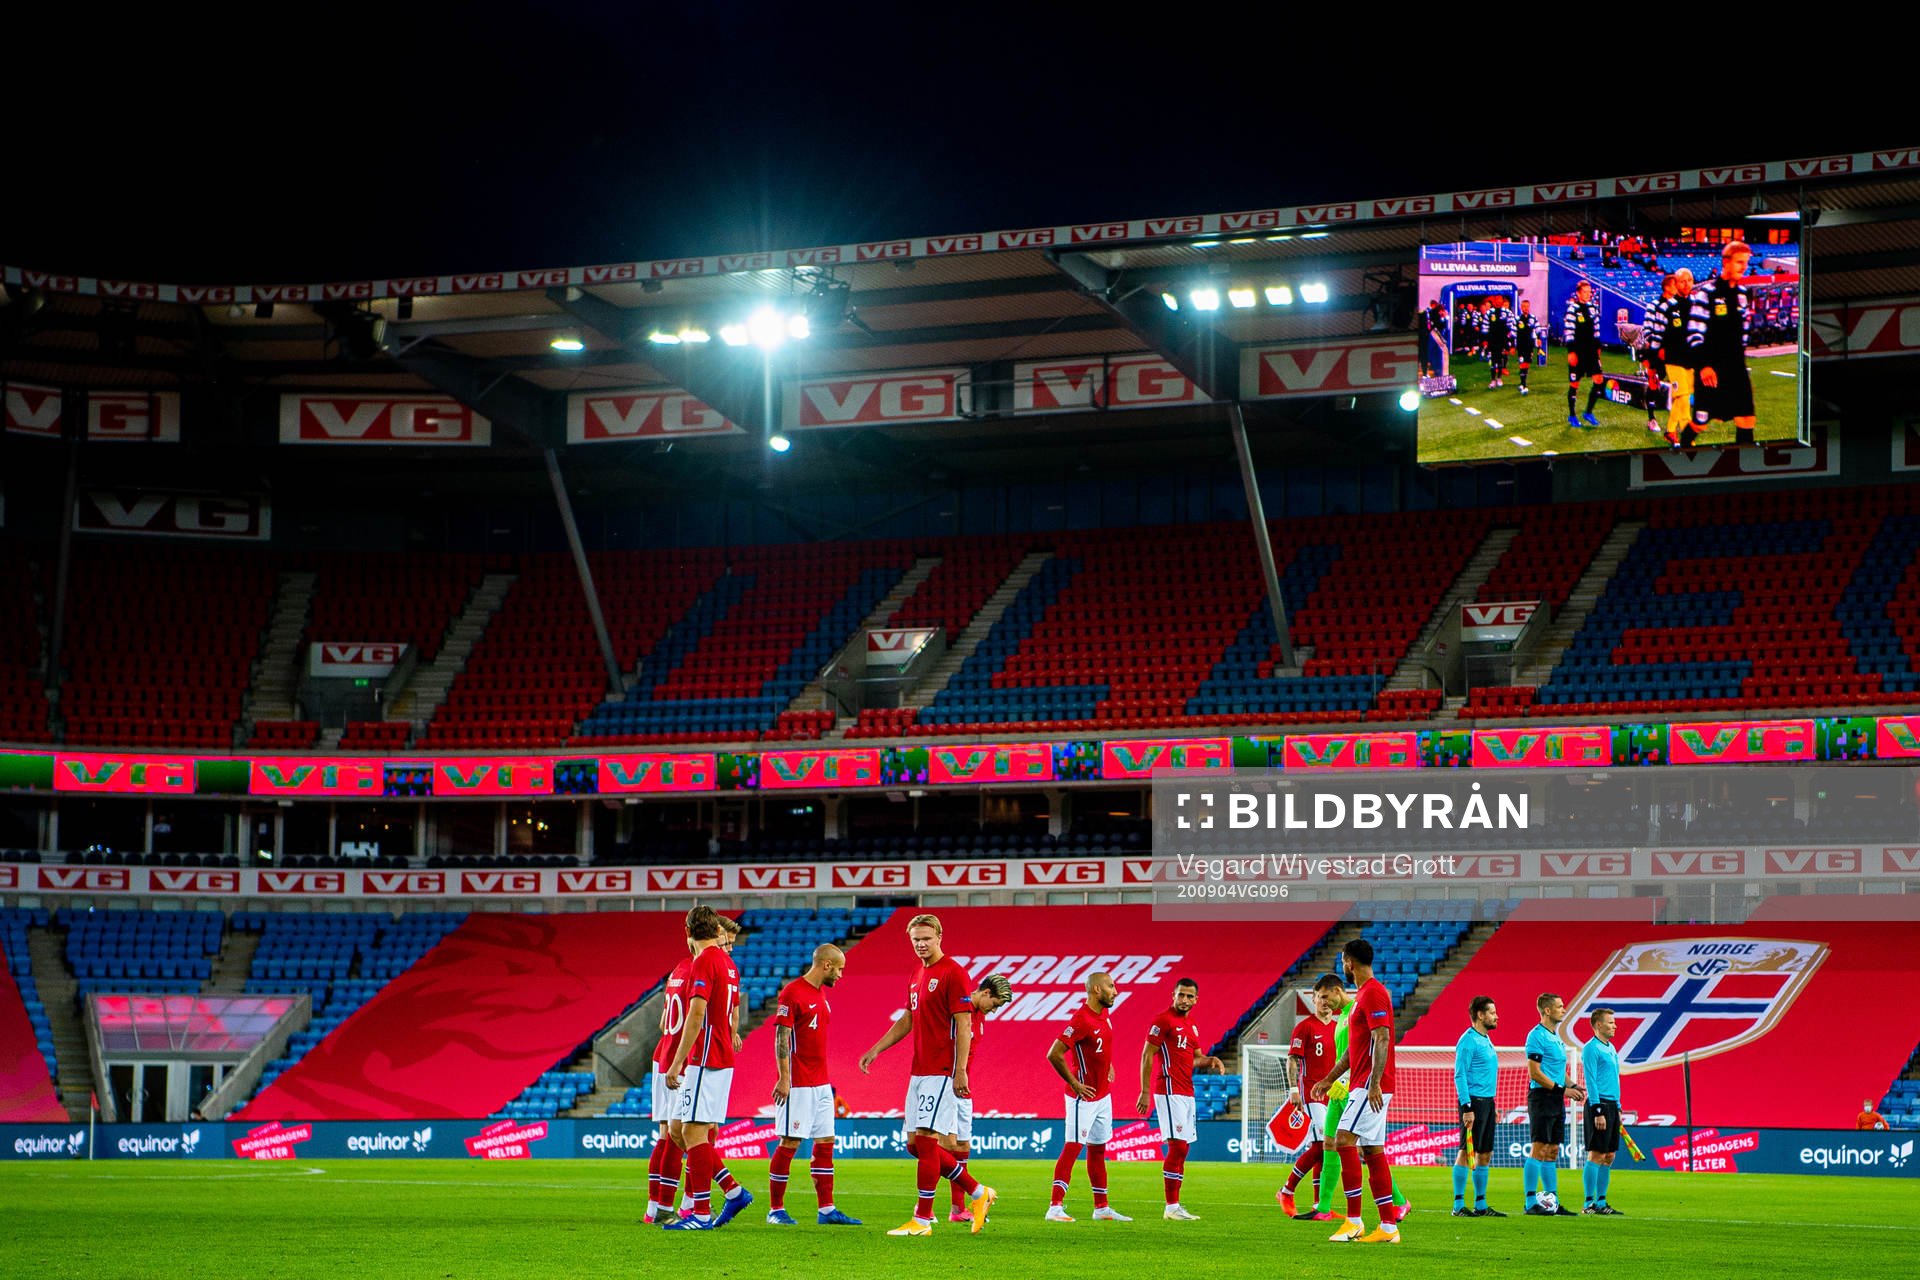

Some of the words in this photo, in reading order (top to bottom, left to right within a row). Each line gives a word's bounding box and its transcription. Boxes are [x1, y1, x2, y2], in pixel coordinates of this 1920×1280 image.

[26, 271, 75, 291] VG
[103, 281, 154, 299] VG
[180, 286, 233, 303] VG
[255, 286, 305, 302] VG
[325, 283, 372, 299] VG
[389, 278, 436, 295] VG
[453, 273, 501, 291] VG
[519, 269, 566, 288] VG
[586, 264, 633, 282] VG
[653, 260, 702, 277] VG
[788, 248, 838, 266] VG
[858, 241, 908, 260] VG
[930, 235, 980, 254] VG
[1001, 230, 1053, 248] VG
[1073, 223, 1126, 242] VG
[1146, 216, 1202, 236] VG
[1223, 210, 1278, 229] VG
[1300, 204, 1356, 224] VG
[1375, 197, 1433, 217] VG
[1455, 190, 1513, 209] VG
[1535, 182, 1595, 203] VG
[1617, 174, 1679, 193] VG
[1702, 165, 1764, 184] VG
[1788, 157, 1850, 178] VG
[1431, 262, 1478, 272] ULLEVAAL
[1480, 264, 1517, 273] STADION
[1808, 307, 1920, 351] V
[1264, 345, 1418, 391] VG
[1034, 364, 1185, 408] VG
[804, 379, 946, 421] VG
[305, 401, 463, 439] VG
[589, 396, 727, 435] VG
[87, 492, 250, 532] VG
[1466, 605, 1536, 625] VG
[327, 646, 393, 664] VG
[62, 760, 186, 786] VG
[259, 764, 375, 789] VG
[440, 764, 544, 788] VG
[606, 760, 706, 786] VG
[767, 755, 872, 782] VG
[935, 749, 1045, 777] VG
[1109, 744, 1223, 772] VG
[1290, 737, 1407, 766] VG
[1477, 731, 1603, 761] VG
[1678, 724, 1804, 757] VG
[42, 868, 124, 889] VG
[152, 871, 235, 891] VG
[261, 872, 339, 892] VG
[366, 873, 442, 893] VG
[464, 873, 537, 893] VG
[560, 872, 628, 892] VG
[651, 869, 719, 890] VG
[742, 868, 813, 889] VG
[835, 866, 907, 887] VG
[929, 864, 1003, 885] VG
[1026, 863, 1101, 883] VG
[1544, 855, 1625, 877] VG
[1655, 852, 1740, 874] VG
[1769, 850, 1856, 872] VG
[1687, 943, 1760, 955] NORGE
[809, 1013, 818, 1030] 4
[1095, 1037, 1103, 1053] 2
[1176, 1034, 1188, 1050] 14
[1315, 1041, 1323, 1057] 8
[918, 1094, 935, 1112] 23
[14, 1136, 66, 1157] equinor
[118, 1136, 179, 1157] equinor
[347, 1132, 410, 1154] equinor
[582, 1131, 647, 1152] equinor
[714, 1129, 778, 1149] ORGENDAGEN
[834, 1131, 888, 1153] quinor
[971, 1131, 1027, 1154] quinor
[1105, 1132, 1162, 1151] ORGENDAG
[1383, 1132, 1460, 1155] ORGENDAGENS
[725, 1145, 761, 1158] HELTER
[1117, 1148, 1156, 1161] HELTER
[1395, 1152, 1436, 1165] HELTER
[1800, 1144, 1884, 1169] equinor
[1682, 1158, 1727, 1171] HELTER
